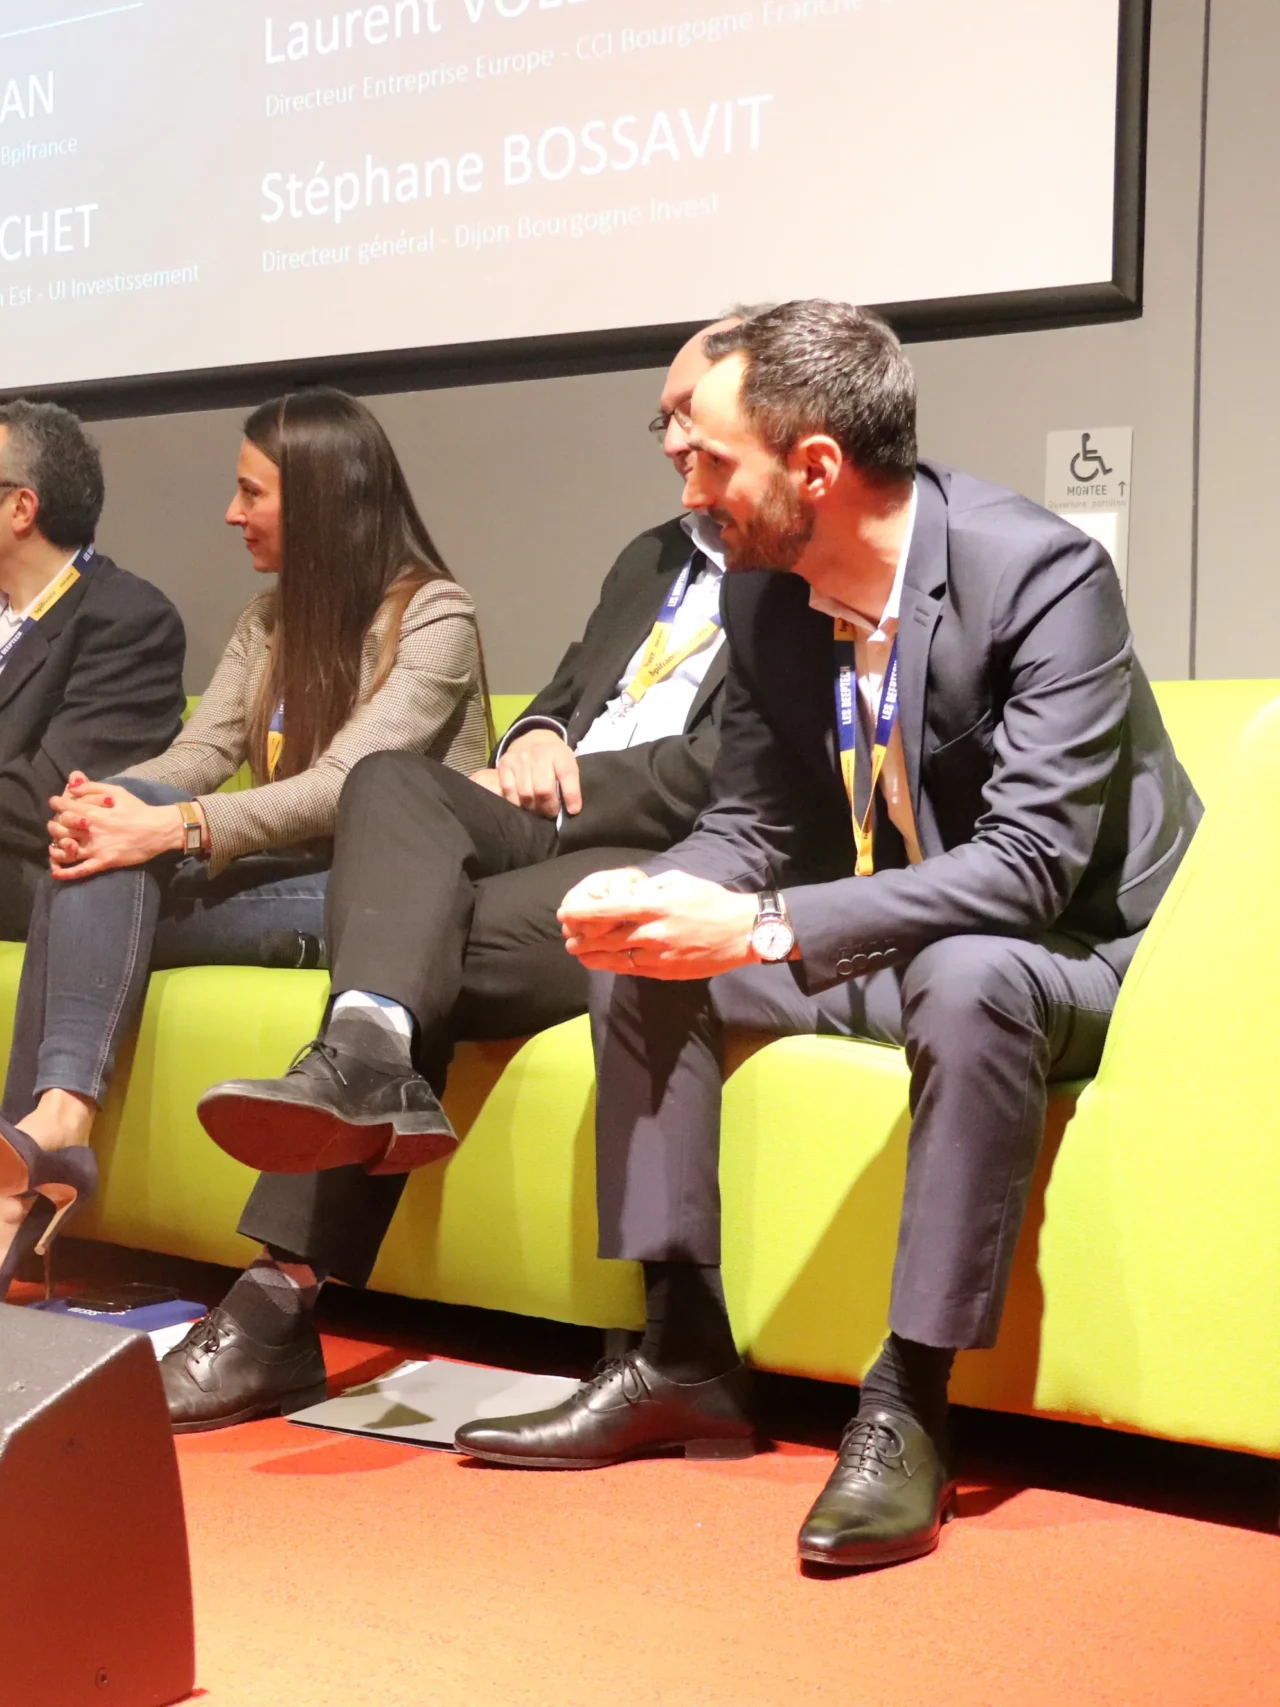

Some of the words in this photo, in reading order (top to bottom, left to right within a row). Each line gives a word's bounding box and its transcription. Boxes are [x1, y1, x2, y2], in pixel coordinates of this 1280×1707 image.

[266, 0, 442, 64] Laurent
[266, 84, 356, 117] Directeur
[363, 63, 469, 99] Entreprise
[476, 48, 554, 79] Europe
[576, 31, 613, 60] CCI
[621, 11, 753, 52] Bourgogne
[0, 135, 79, 168] Bpifrance
[260, 154, 484, 223] Stéphane
[504, 93, 774, 186] BOSSAVIT
[262, 245, 350, 273] Directeur
[358, 227, 434, 265] général
[454, 222, 510, 251] Dijon
[517, 206, 643, 240] Bourgogne
[8, 284, 32, 307] Est
[48, 279, 68, 302] UI
[71, 261, 201, 299] Investissement
[1066, 484, 1107, 496] MONTEE
[839, 664, 852, 708] DEEPTECH
[841, 708, 852, 726] LES
[881, 702, 895, 721] LES
